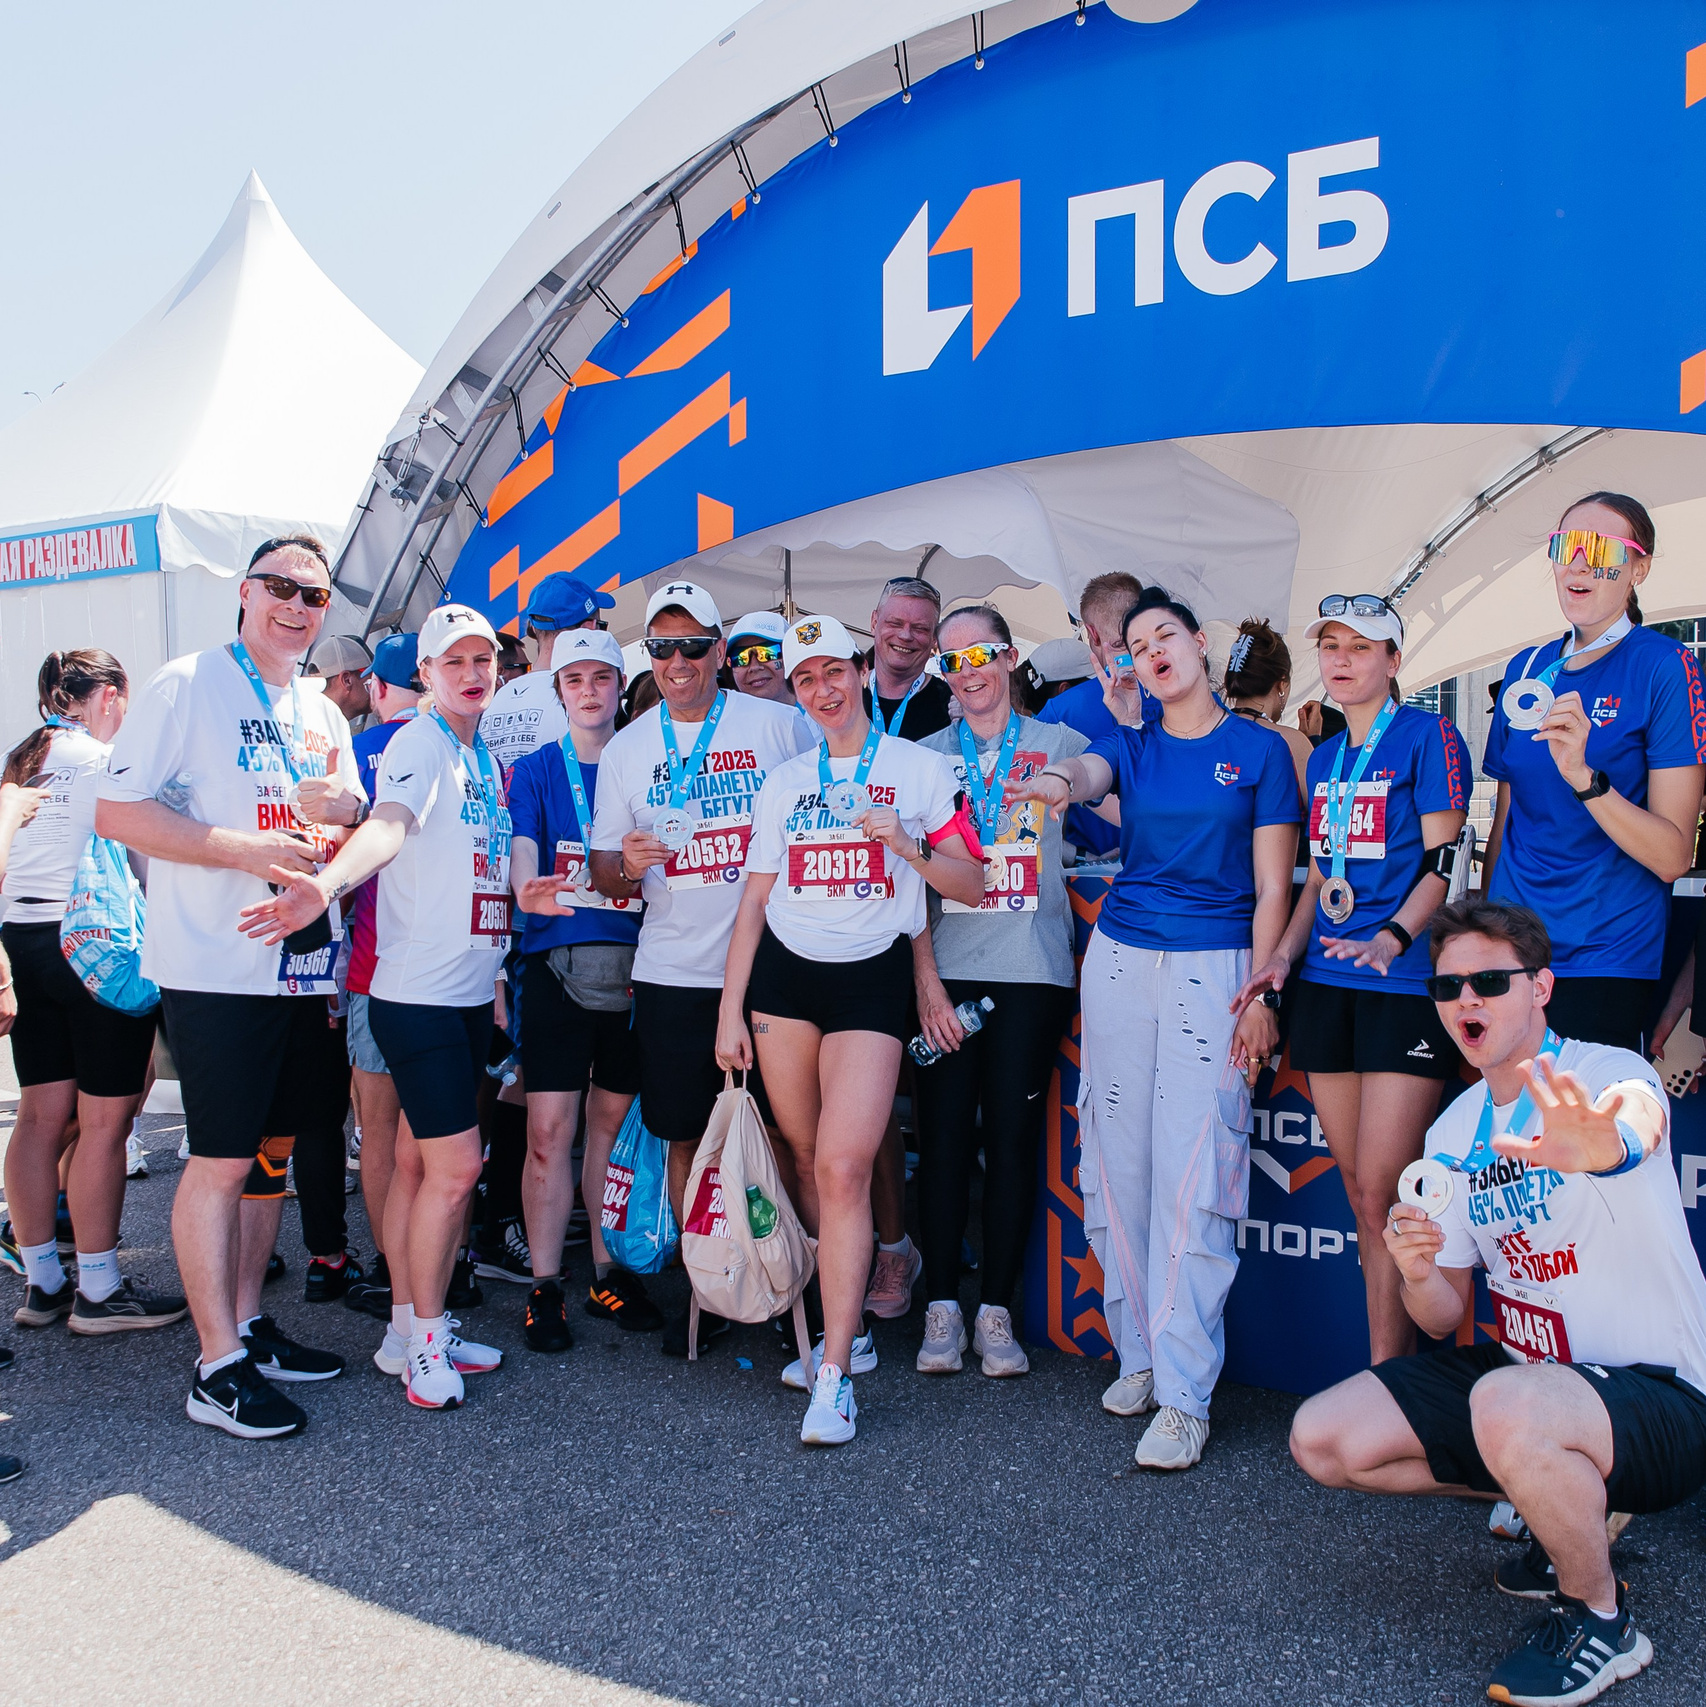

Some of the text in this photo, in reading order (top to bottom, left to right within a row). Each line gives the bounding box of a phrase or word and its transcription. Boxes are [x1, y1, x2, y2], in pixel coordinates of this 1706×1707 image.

[1068, 136, 1389, 317] ПСБ
[23, 523, 138, 580] РАЗДЕВАЛКА
[1591, 709, 1618, 718] ПСБ
[1369, 728, 1381, 744] ПСБ
[238, 746, 280, 772] 45%
[864, 746, 874, 759] ПСБ
[1214, 771, 1239, 780] ПСБ
[43, 794, 70, 804] СЕБЕ
[701, 793, 754, 819] БЕГУТ
[988, 803, 997, 818] ПСБ
[1318, 803, 1374, 836] 254
[675, 834, 744, 871] 20532
[803, 848, 870, 881] 20312
[479, 899, 508, 930] 20531
[286, 946, 331, 976] 30366
[1406, 1050, 1434, 1059] DEMIX
[1468, 1190, 1506, 1227] 45%
[1236, 1220, 1362, 1265] ПОР
[1500, 1303, 1560, 1358] 20451
